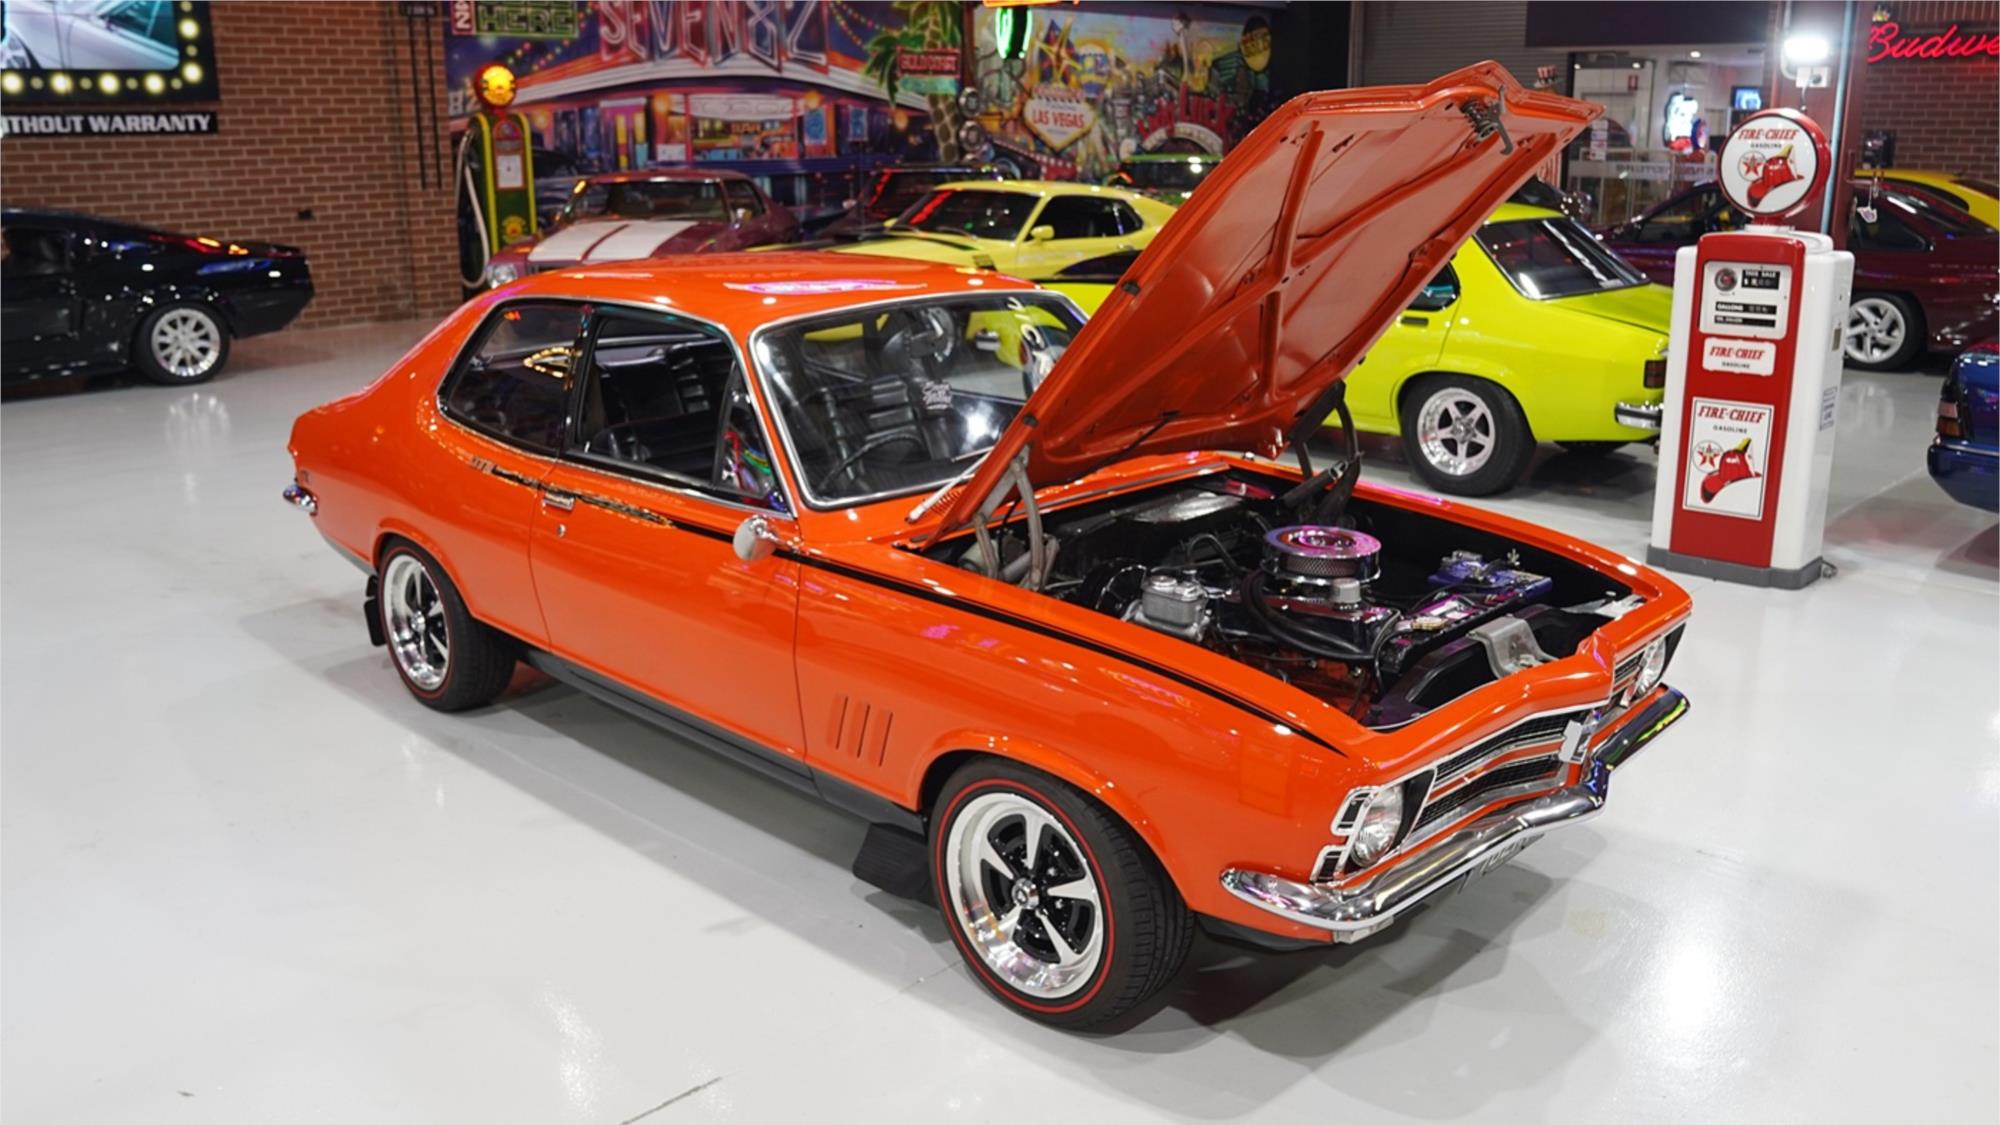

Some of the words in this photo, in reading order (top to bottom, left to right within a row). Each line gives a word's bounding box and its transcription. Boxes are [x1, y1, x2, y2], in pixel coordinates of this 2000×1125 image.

[478, 6, 574, 34] HERE
[1867, 21, 1999, 63] Budwe
[88, 114, 211, 133] WARRANTY
[1033, 109, 1049, 125] LAS
[1053, 112, 1084, 129] VEGAS
[1738, 128, 1799, 140] FIRE-CHIEF
[1709, 346, 1765, 360] FIRE-CHIEF
[1722, 361, 1750, 369] GASOLINE
[1698, 406, 1766, 423] FIRE-CHIEF
[1713, 425, 1748, 434] GASOLINE
